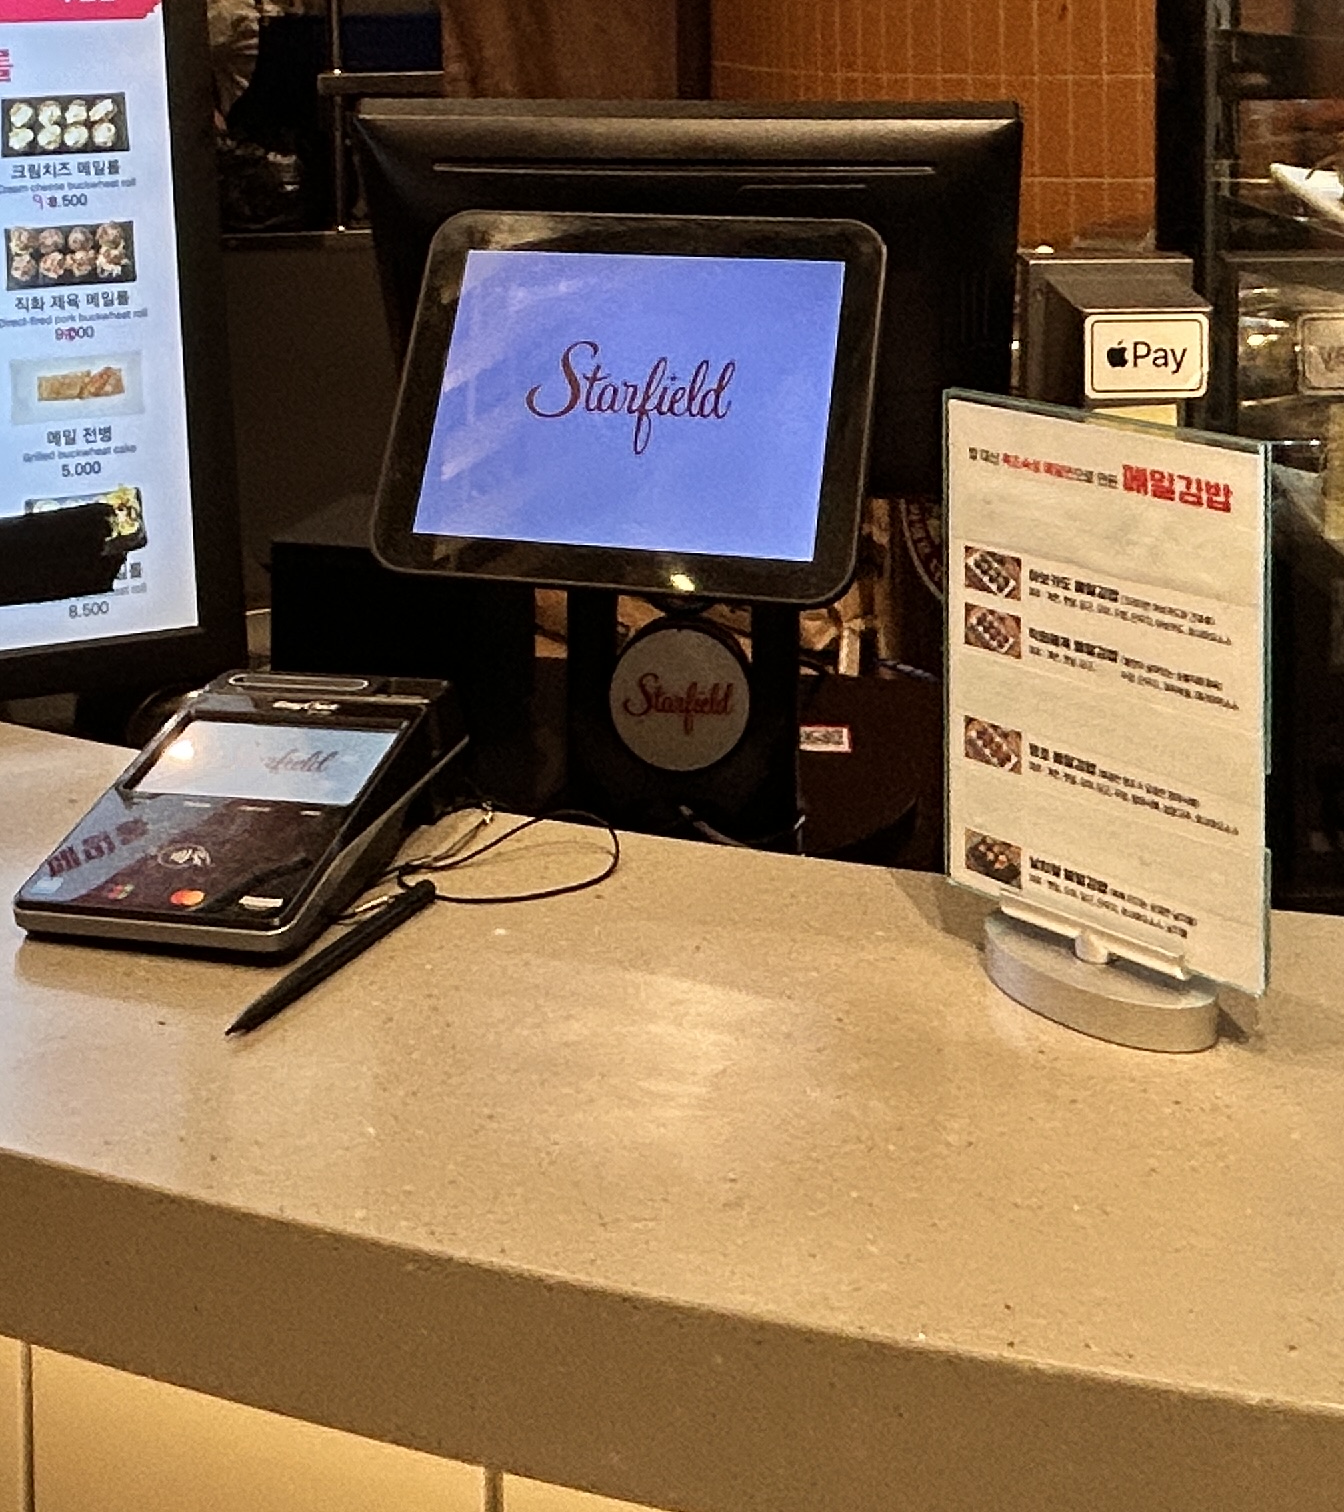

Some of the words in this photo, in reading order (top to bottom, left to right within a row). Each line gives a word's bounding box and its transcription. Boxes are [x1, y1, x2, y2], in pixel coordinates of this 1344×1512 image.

[10, 161, 73, 180] 크림치즈
[1132, 341, 1188, 374] Pay
[525, 340, 737, 455] Starfield
[46, 428, 77, 447] 메밀
[82, 424, 113, 444] 전병
[61, 460, 102, 478] 5.000
[1121, 464, 1234, 514] 메밀김밥
[68, 600, 110, 619] 8.500
[622, 672, 735, 736] Starfield
